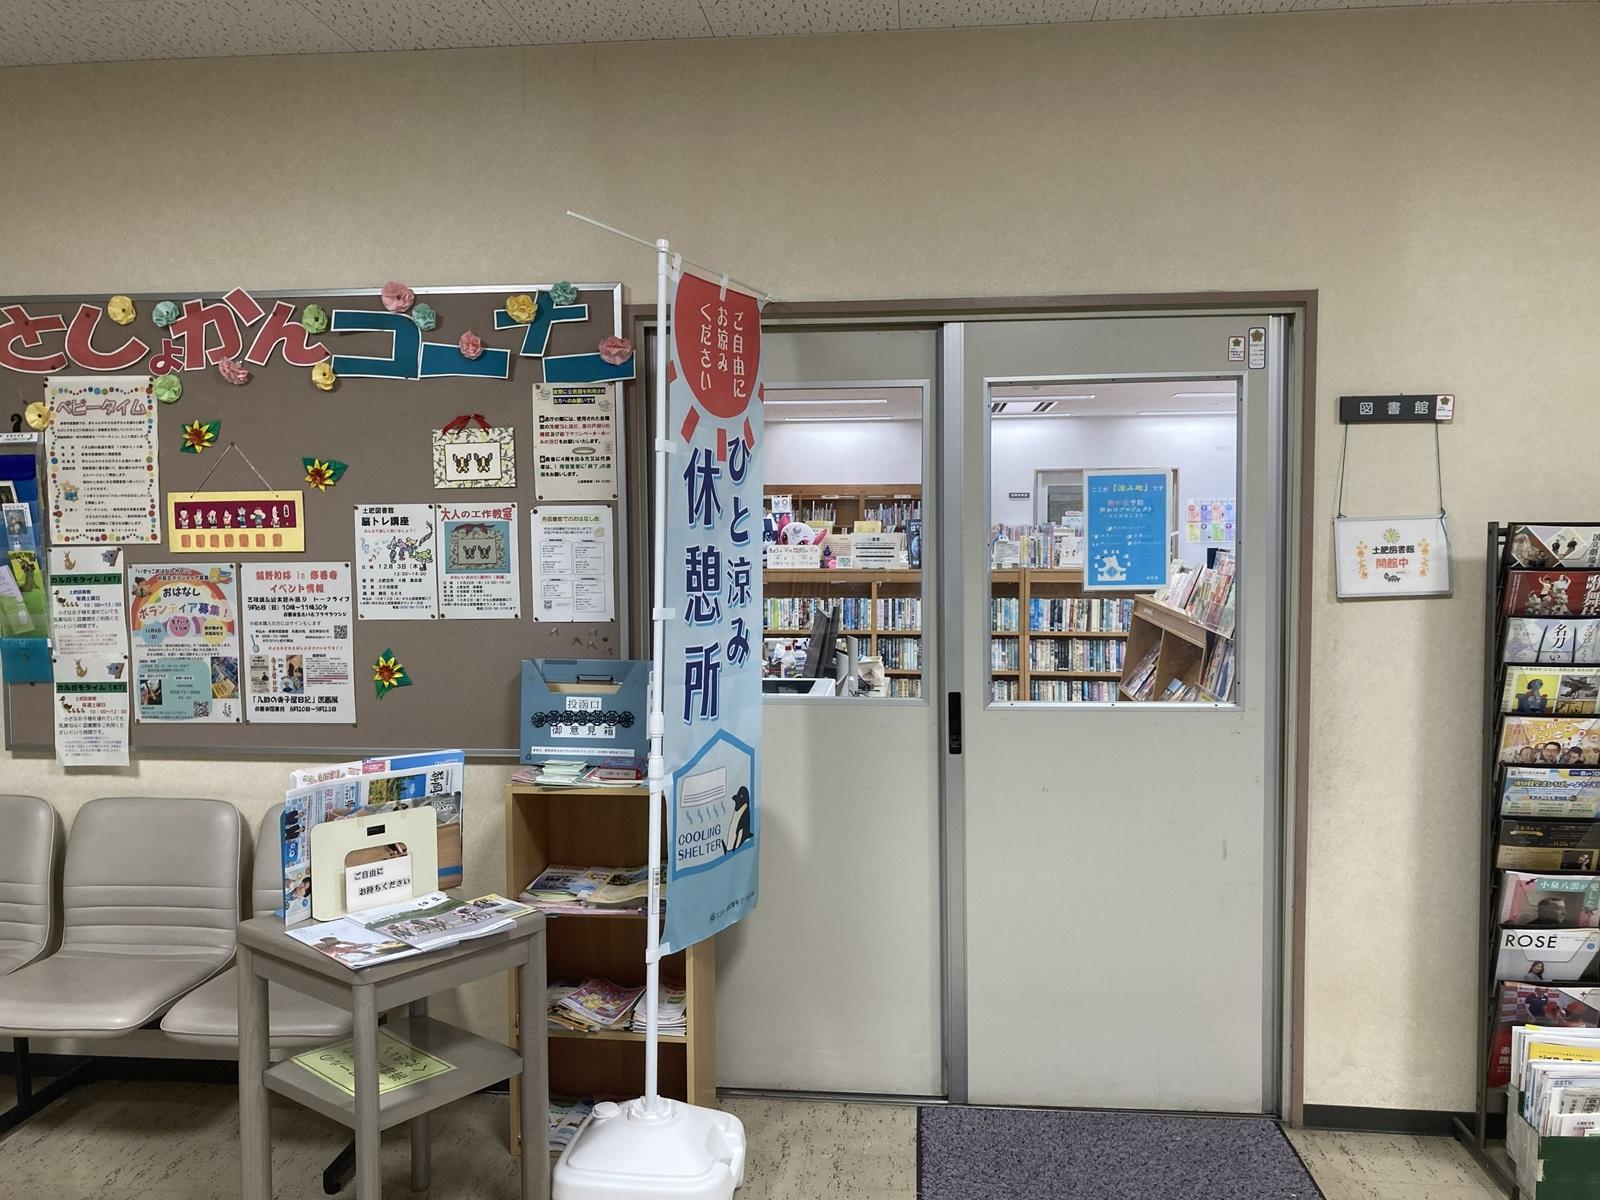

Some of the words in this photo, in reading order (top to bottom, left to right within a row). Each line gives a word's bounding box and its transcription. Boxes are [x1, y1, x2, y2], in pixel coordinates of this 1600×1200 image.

[717, 306, 728, 372] お涼み
[700, 303, 712, 391] ください
[733, 312, 746, 398] ご自由に
[56, 399, 147, 416] ベビータイム
[1360, 400, 1430, 415] 図書館
[361, 516, 410, 527] 脳トレ講座
[441, 507, 513, 521] 大人の工作教室
[727, 436, 751, 665] ひと涼み
[1372, 545, 1415, 555] 土肥図書館
[1375, 556, 1409, 569] 開館中
[163, 586, 200, 597] おはなし
[270, 584, 324, 593] イベント情報
[683, 447, 722, 724] 休憩所
[139, 602, 228, 619] ボランティア募集！
[568, 700, 599, 709] 投函口
[552, 726, 614, 736] 御意見箱
[678, 824, 721, 846] COOLING
[678, 838, 722, 861] SHELTER
[354, 867, 384, 880] ご自由に
[358, 877, 411, 896] お持ちください
[1505, 934, 1558, 949] ROSE
